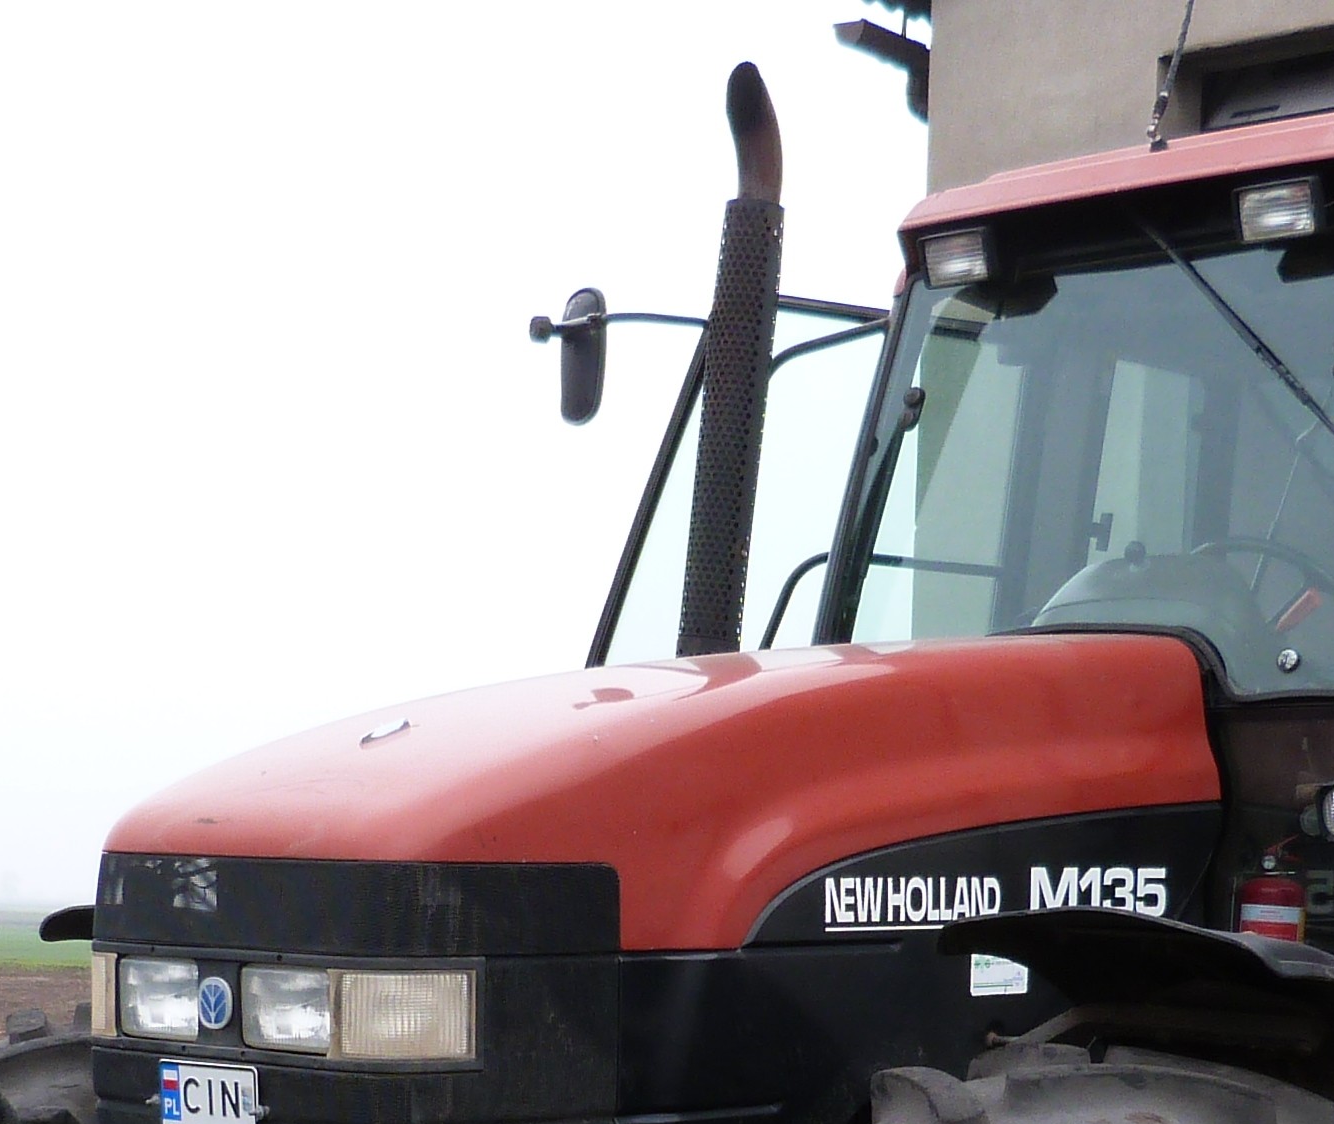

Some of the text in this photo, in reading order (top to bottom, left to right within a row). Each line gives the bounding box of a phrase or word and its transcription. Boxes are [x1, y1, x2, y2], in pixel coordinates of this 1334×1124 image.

[825, 876, 1001, 923] NEW HOLLAND
[1030, 866, 1166, 917] M135
[164, 1097, 180, 1116] PL
[183, 1078, 241, 1118] CIN
